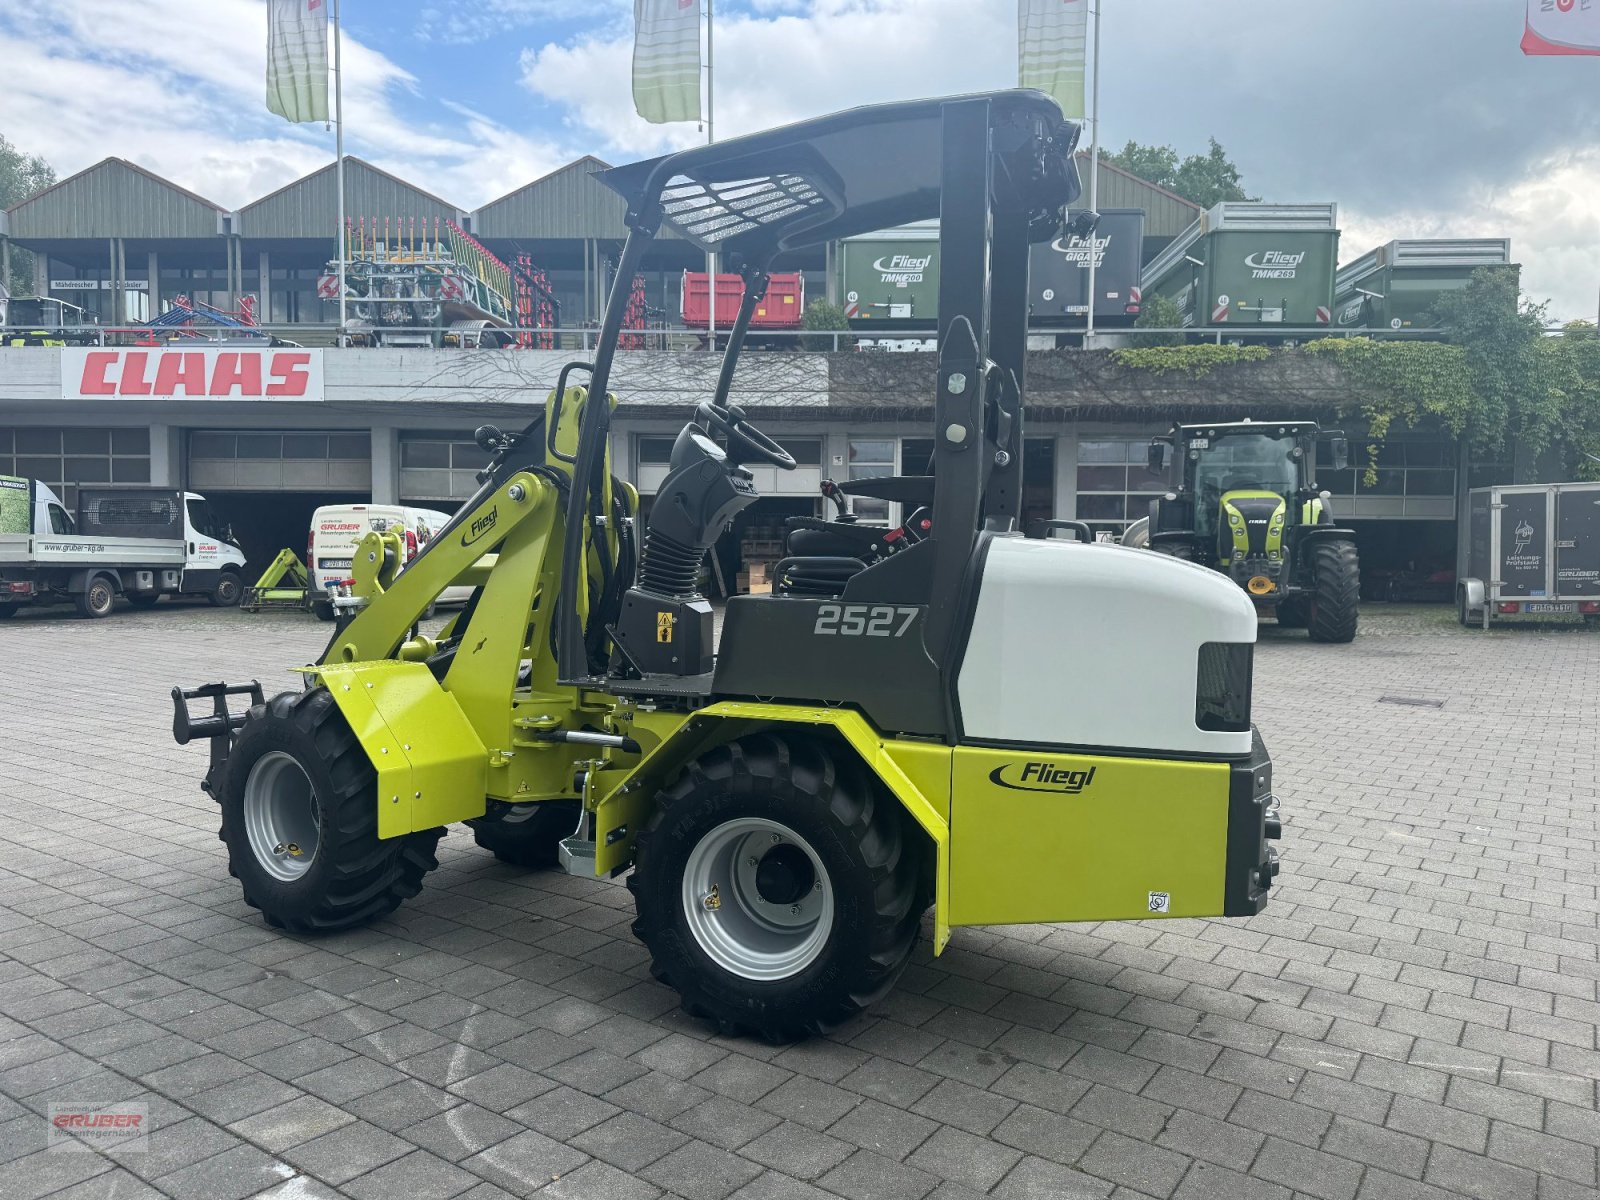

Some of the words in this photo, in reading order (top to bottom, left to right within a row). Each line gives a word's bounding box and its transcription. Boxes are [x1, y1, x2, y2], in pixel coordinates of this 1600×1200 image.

[890, 255, 931, 269] Fliegl
[1262, 251, 1305, 266] Fliegl
[881, 274, 904, 282] TMK
[1252, 270, 1276, 278] TMK
[55, 280, 94, 288] Mähdrescher
[80, 352, 311, 396] CLAAS
[471, 504, 498, 537] Fliegl
[44, 544, 105, 553] www.gruber-kg.de
[814, 605, 919, 637] 2527
[1020, 762, 1096, 789] Fliegl
